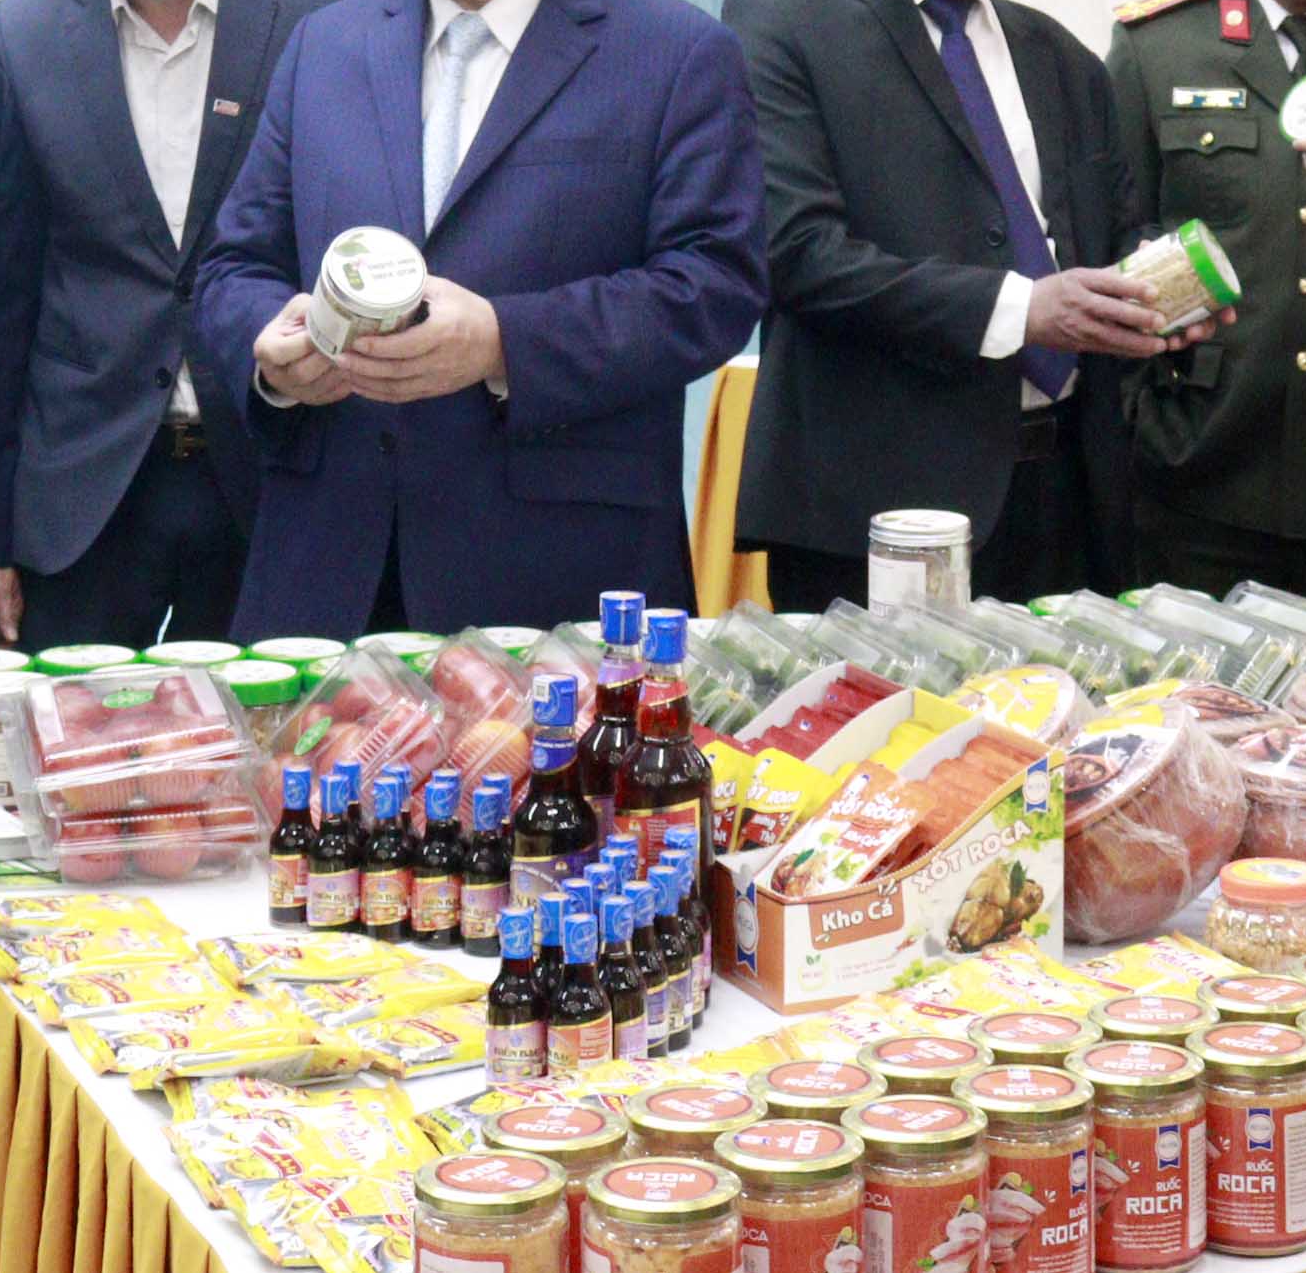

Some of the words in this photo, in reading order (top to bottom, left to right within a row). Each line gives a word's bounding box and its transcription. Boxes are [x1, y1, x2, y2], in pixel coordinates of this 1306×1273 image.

[911, 848, 962, 895] XỐT
[966, 818, 1032, 865] ROCA
[821, 908, 864, 933] Kho
[867, 897, 895, 920] Cá
[1217, 1172, 1276, 1194] ROCA
[862, 1191, 893, 1208] OCA
[1125, 1192, 1183, 1216] ROCA
[1040, 1217, 1088, 1247] ROCA
